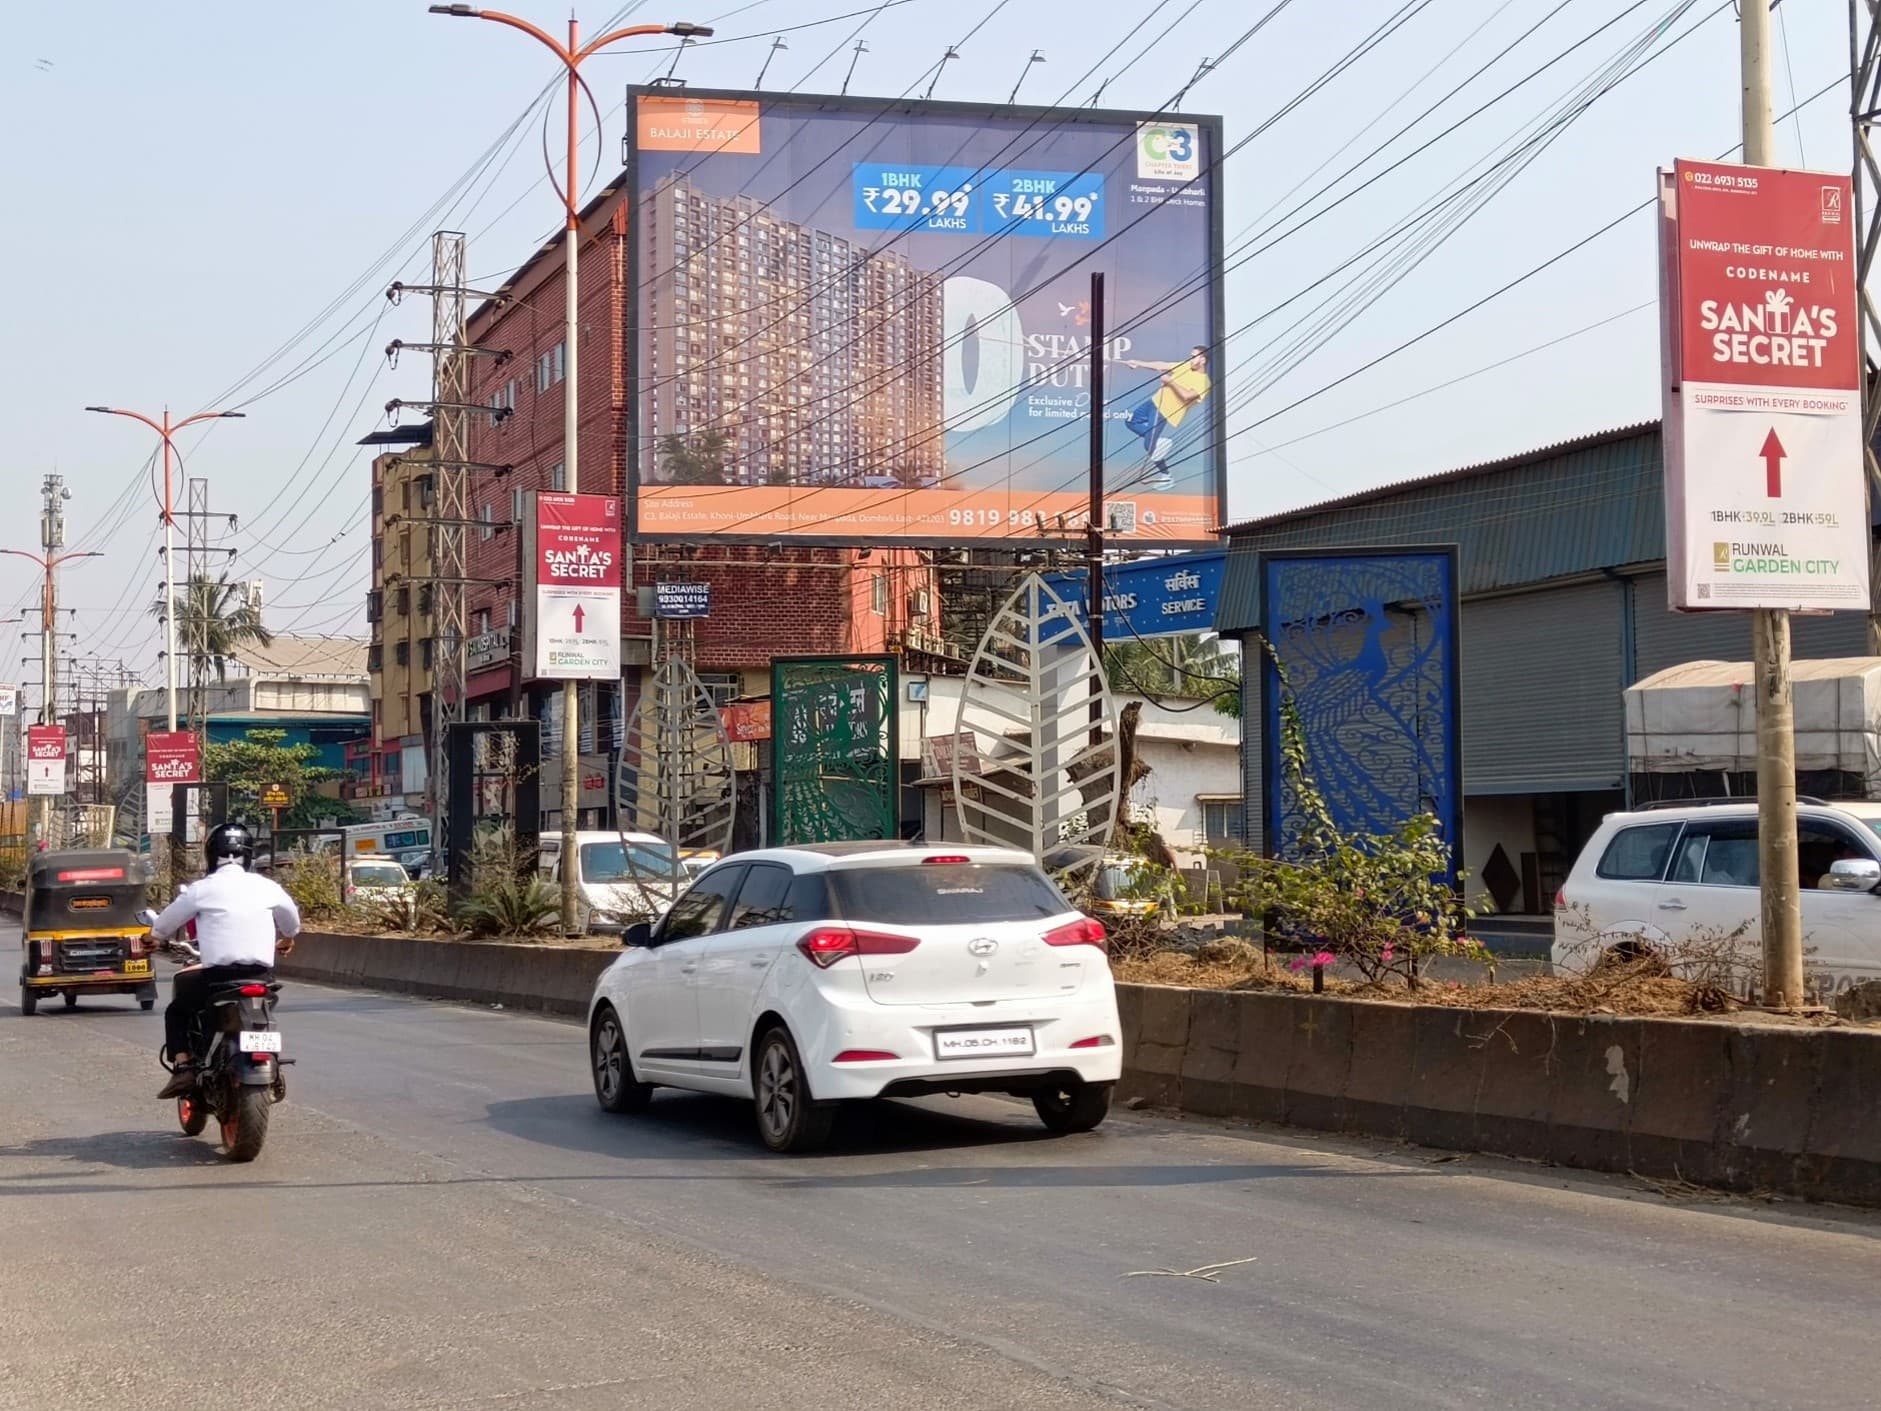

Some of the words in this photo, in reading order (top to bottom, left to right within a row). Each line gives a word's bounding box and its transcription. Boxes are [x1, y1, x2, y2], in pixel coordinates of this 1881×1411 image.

[650, 127, 691, 138] BALAJI
[695, 128, 741, 140] ESTATE
[882, 172, 922, 188] 1BHK
[1012, 179, 1055, 193] 2BHK
[1694, 172, 1712, 185] 022
[1714, 175, 1735, 187] 6931
[1737, 176, 1758, 189] 5135
[928, 218, 967, 229] LAKHS
[1052, 222, 1089, 234] LAKHS
[1690, 239, 1731, 253] UNWRAP
[1733, 243, 1751, 254] THE
[1752, 245, 1774, 256] GIFT
[1775, 246, 1789, 257] OF
[1791, 248, 1819, 260] HOME
[1820, 250, 1844, 261] WITH
[1725, 266, 1811, 284] CODENAME
[1700, 289, 1838, 338] SANTA'S
[1712, 332, 1827, 367] SECRET
[1027, 362, 1108, 388] DUT
[1028, 395, 1073, 407] Exclusive
[1695, 394, 1744, 406] SURPRISES
[1746, 397, 1770, 407] WITH
[1772, 398, 1802, 410] EVERY
[1028, 407, 1043, 418] for
[1044, 407, 1078, 418] limited
[1113, 409, 1134, 421] only
[949, 509, 1000, 527] 9819
[557, 535, 600, 543] CODENAME
[545, 545, 612, 566] SANTA'S
[1732, 542, 1789, 557] RUNWAL
[550, 563, 607, 578] SECRET
[1733, 558, 1801, 574] GARDEN
[1805, 560, 1840, 575] CITY
[657, 585, 710, 594] MEDIAWISE
[1161, 598, 1208, 616] SERVICE
[154, 769, 190, 779] SECRET
